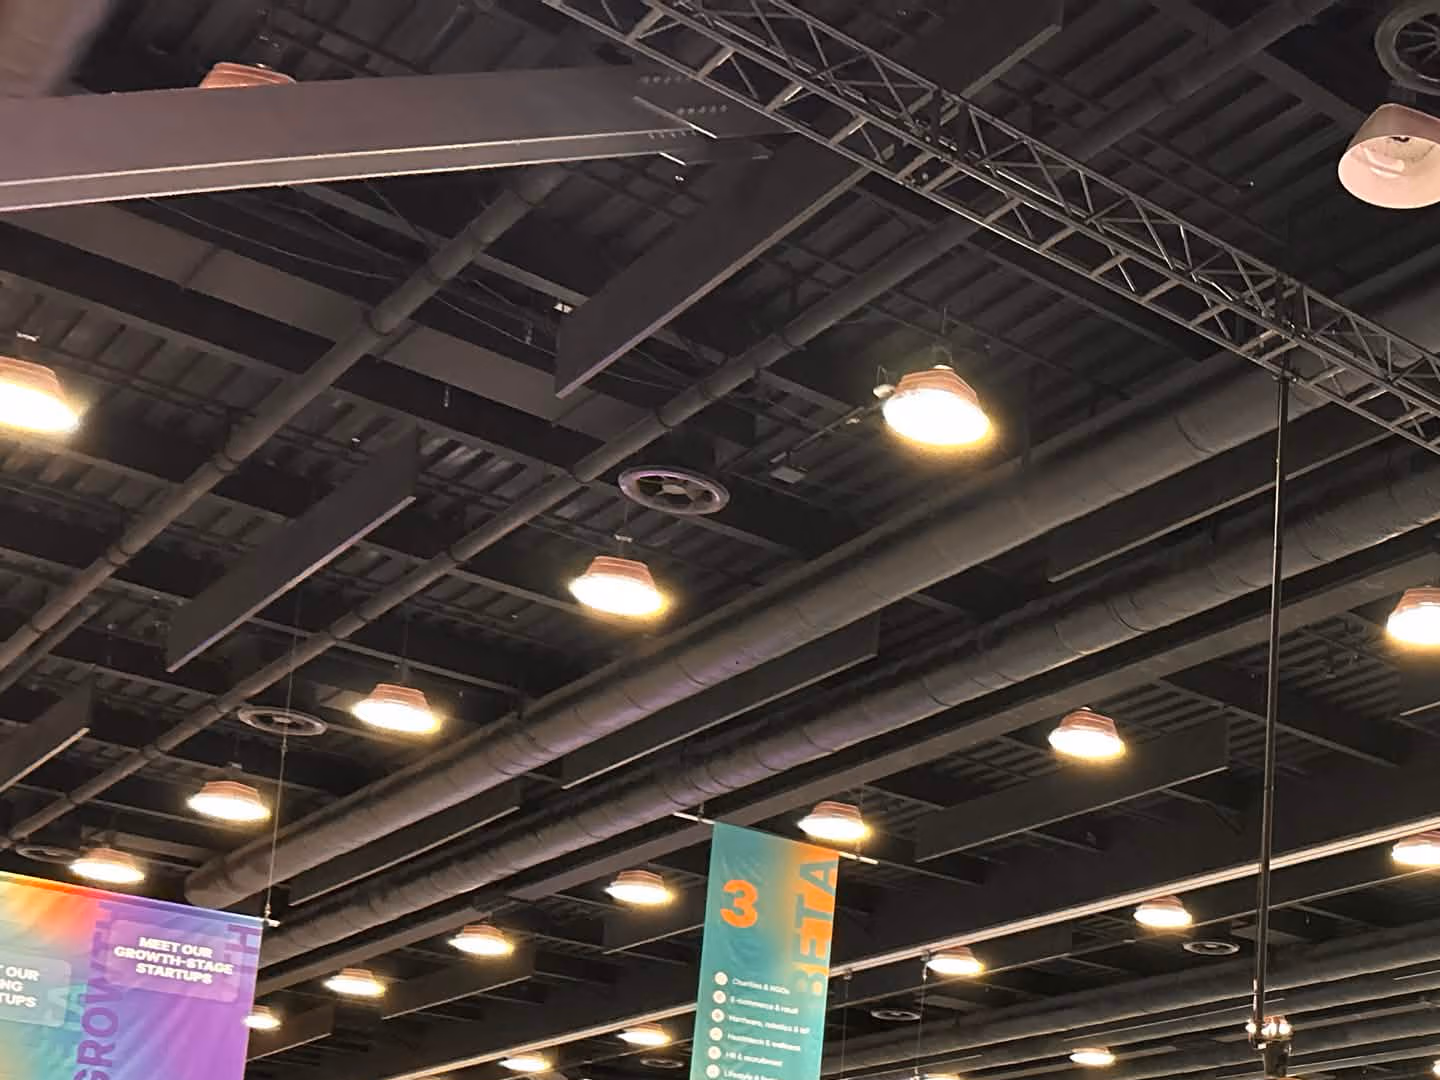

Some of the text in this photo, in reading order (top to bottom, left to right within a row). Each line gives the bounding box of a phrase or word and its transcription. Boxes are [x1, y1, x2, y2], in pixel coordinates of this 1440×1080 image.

[720, 879, 758, 928] 3
[139, 937, 214, 959] MEET OUR
[114, 946, 234, 976] GROWTH-STAGE
[6, 966, 40, 981] OUR
[135, 963, 213, 984] STARTUPS
